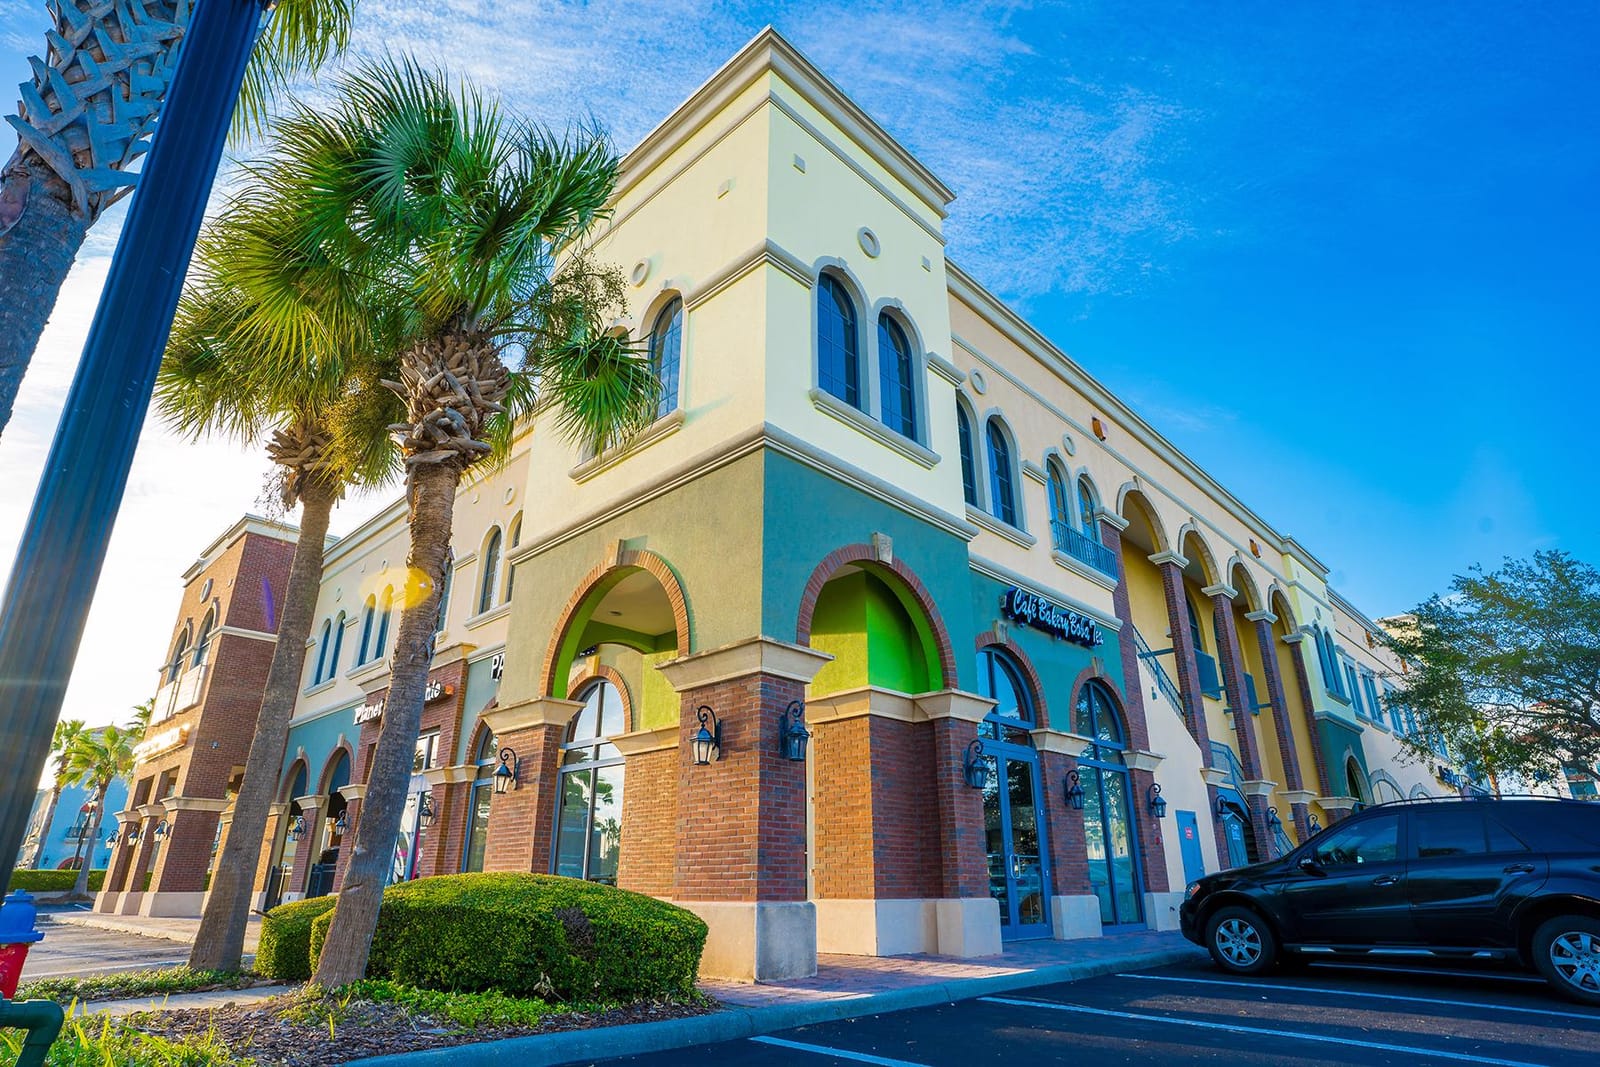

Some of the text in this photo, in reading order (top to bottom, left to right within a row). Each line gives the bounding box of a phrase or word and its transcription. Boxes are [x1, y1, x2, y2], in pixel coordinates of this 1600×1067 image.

[1038, 598, 1070, 637] Bakery
[1069, 612, 1090, 638] Boba
[1089, 620, 1104, 645] Tea
[353, 699, 384, 726] Planet
